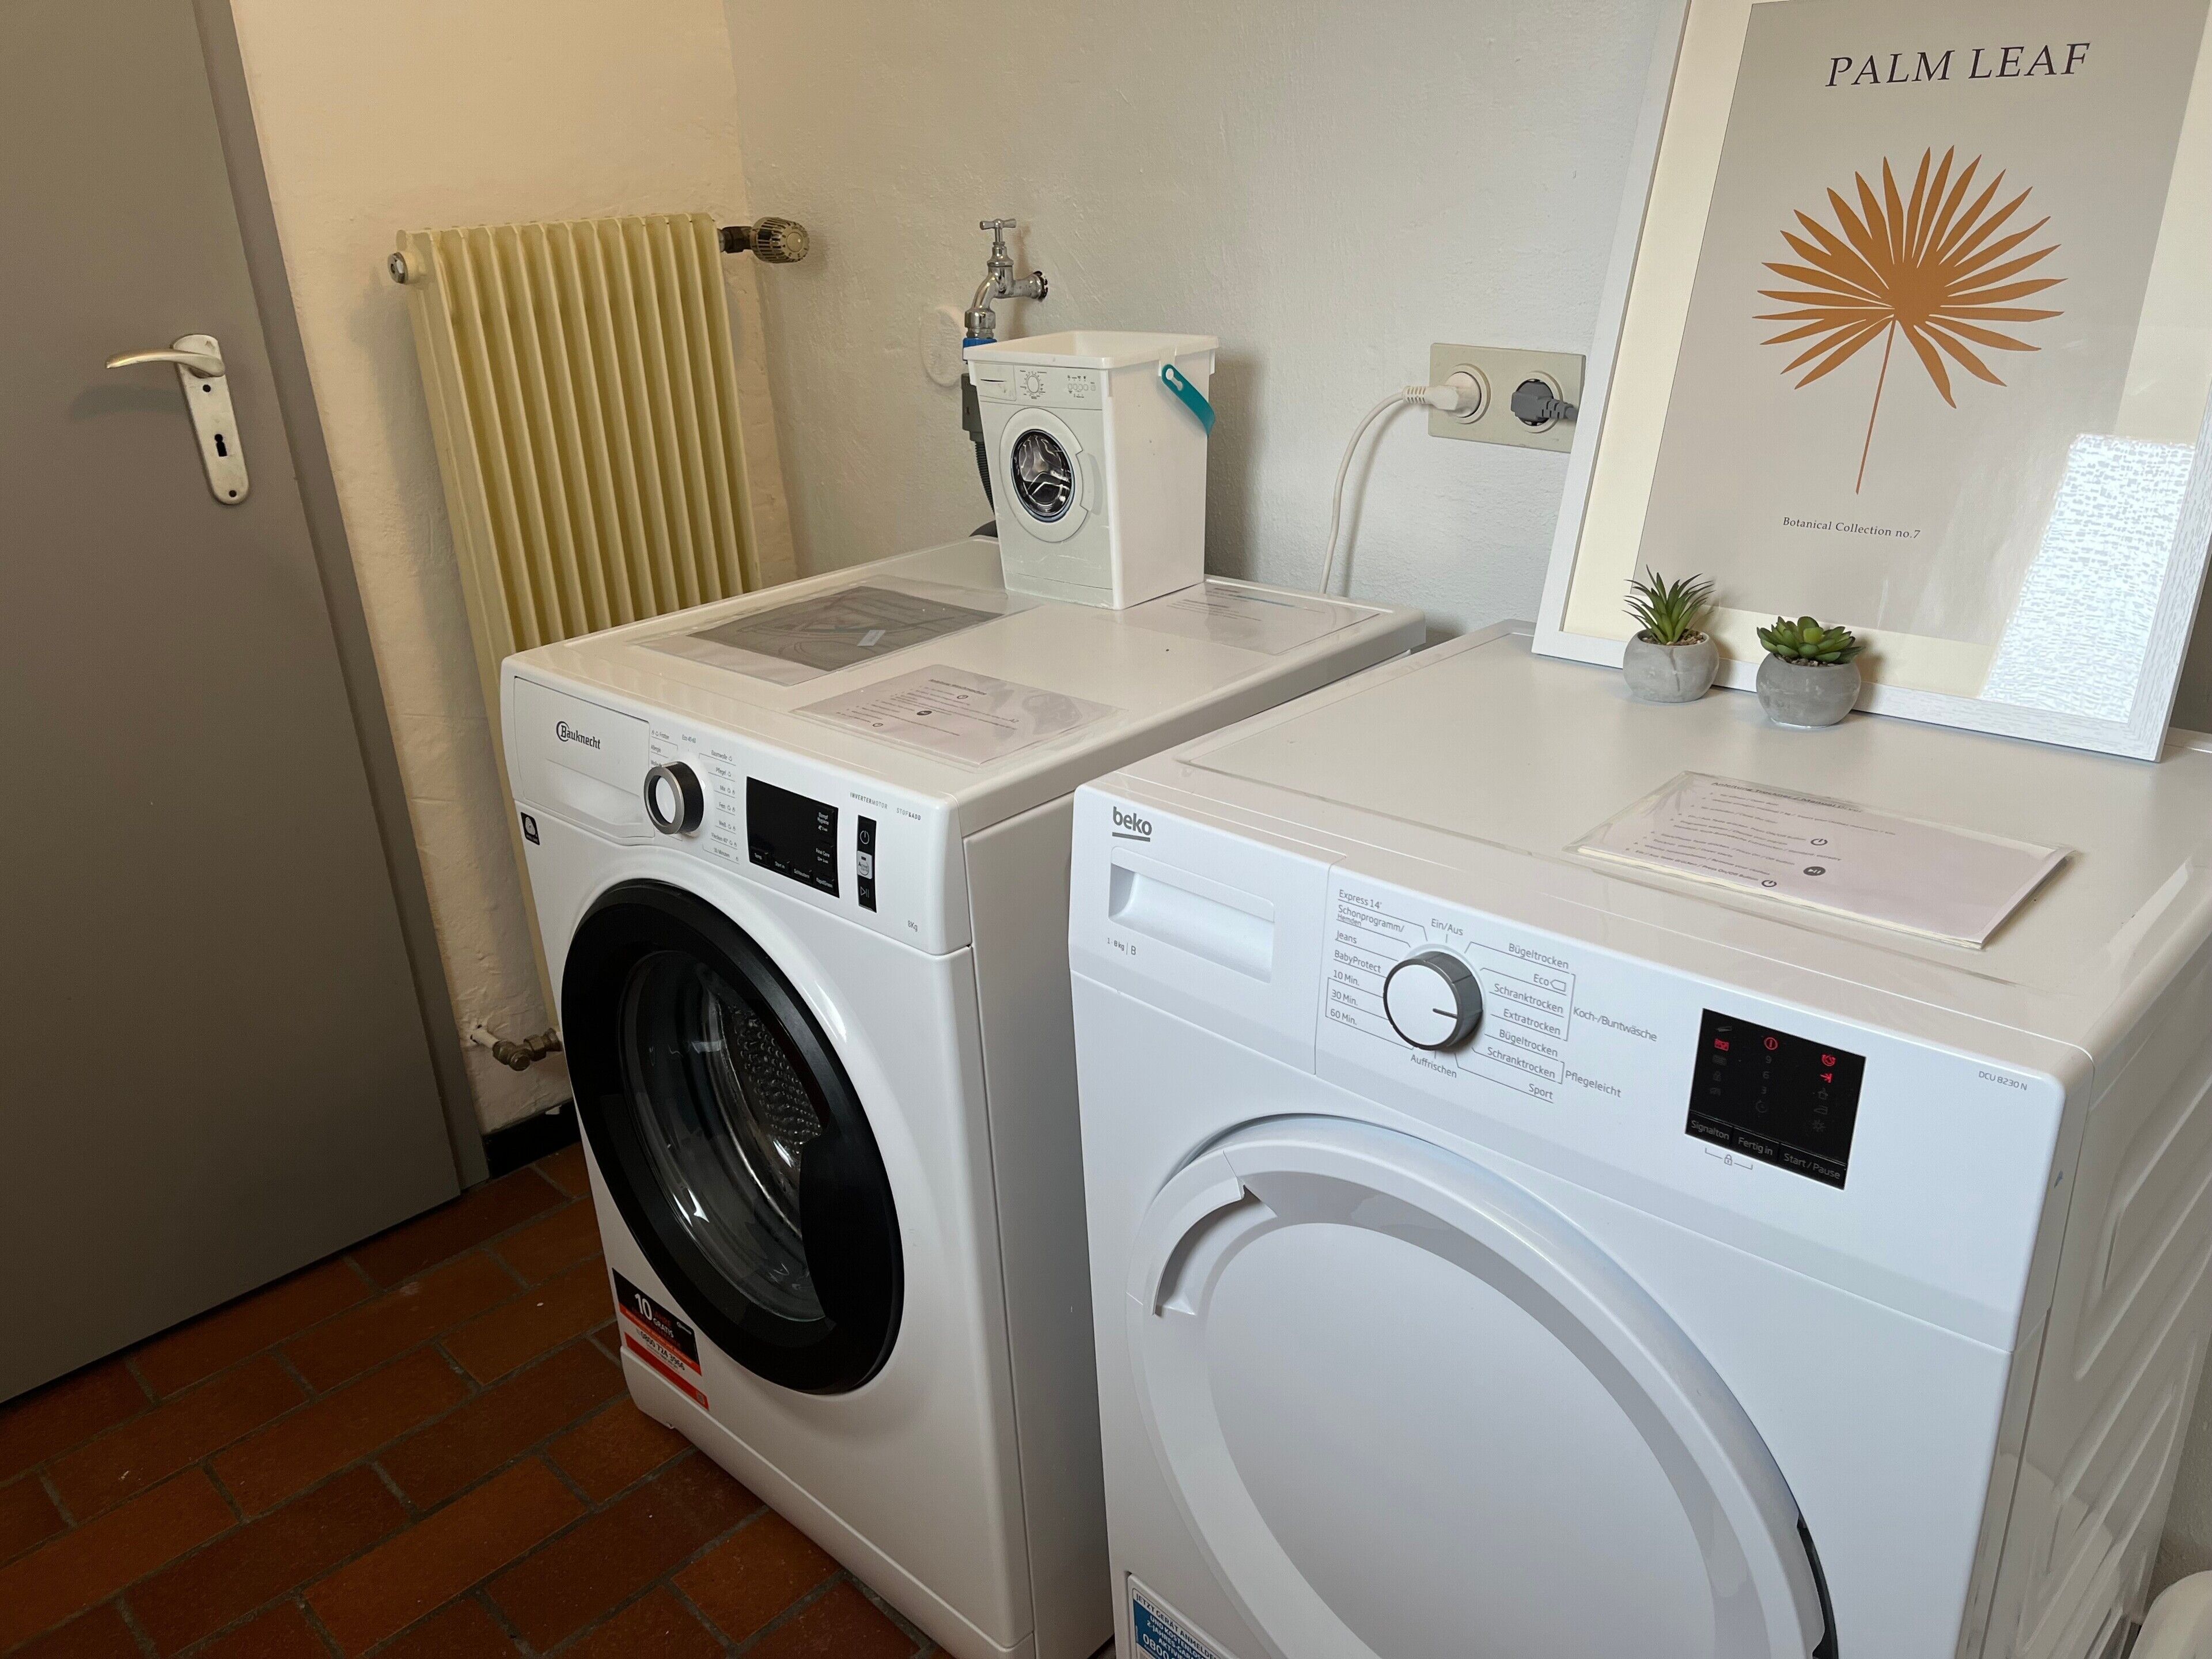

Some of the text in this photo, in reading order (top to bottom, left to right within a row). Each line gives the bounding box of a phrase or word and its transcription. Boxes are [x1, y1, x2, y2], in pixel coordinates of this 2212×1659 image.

[1825, 42, 2090, 88] PALM LEAF
[1783, 517, 1921, 539] Botanical Collection no.7
[558, 722, 600, 749] Bauknecht
[896, 808, 922, 821] STOP&ADD
[1113, 806, 1152, 836] beko
[1339, 889, 1368, 907] Express
[907, 920, 918, 931] 8Kg
[1337, 914, 1362, 927] Hemden
[1338, 904, 1405, 933] Schonprogramm/
[1431, 918, 1464, 936] Ein/Aus
[1335, 930, 1357, 945] Jeans
[1334, 949, 1382, 974] BabyProtect
[1508, 942, 1569, 969] Bügeltrocken
[1333, 969, 1359, 986] 10 Min.
[1533, 974, 1550, 987] Eco
[1331, 989, 1358, 1006] 30 Min.
[1494, 983, 1563, 1014] Schranktrocken
[1330, 1009, 1357, 1025] 60 Min.
[1503, 1008, 1561, 1035] Extratrocken
[1573, 1006, 1657, 1042] Koch-/Buntwäsche
[1499, 1029, 1558, 1057] Bügeltrocken
[1410, 1054, 1457, 1079] Auffrischen
[1487, 1047, 1555, 1079] Schranktrocken
[1528, 1083, 1554, 1100] Sport
[1565, 1070, 1622, 1098] Pflegeleicht
[1978, 1070, 1995, 1081] DCU
[1997, 1076, 2019, 1088] 8230
[1691, 1119, 1730, 1140] Signalton
[1738, 1136, 1773, 1156] Fertig in
[1783, 1153, 1806, 1168] Start
[1813, 1164, 1840, 1179] Pause
[634, 1293, 653, 1321] 10
[1136, 1593, 1154, 1613] JETZT
[1156, 1609, 1179, 1632] GERÄT
